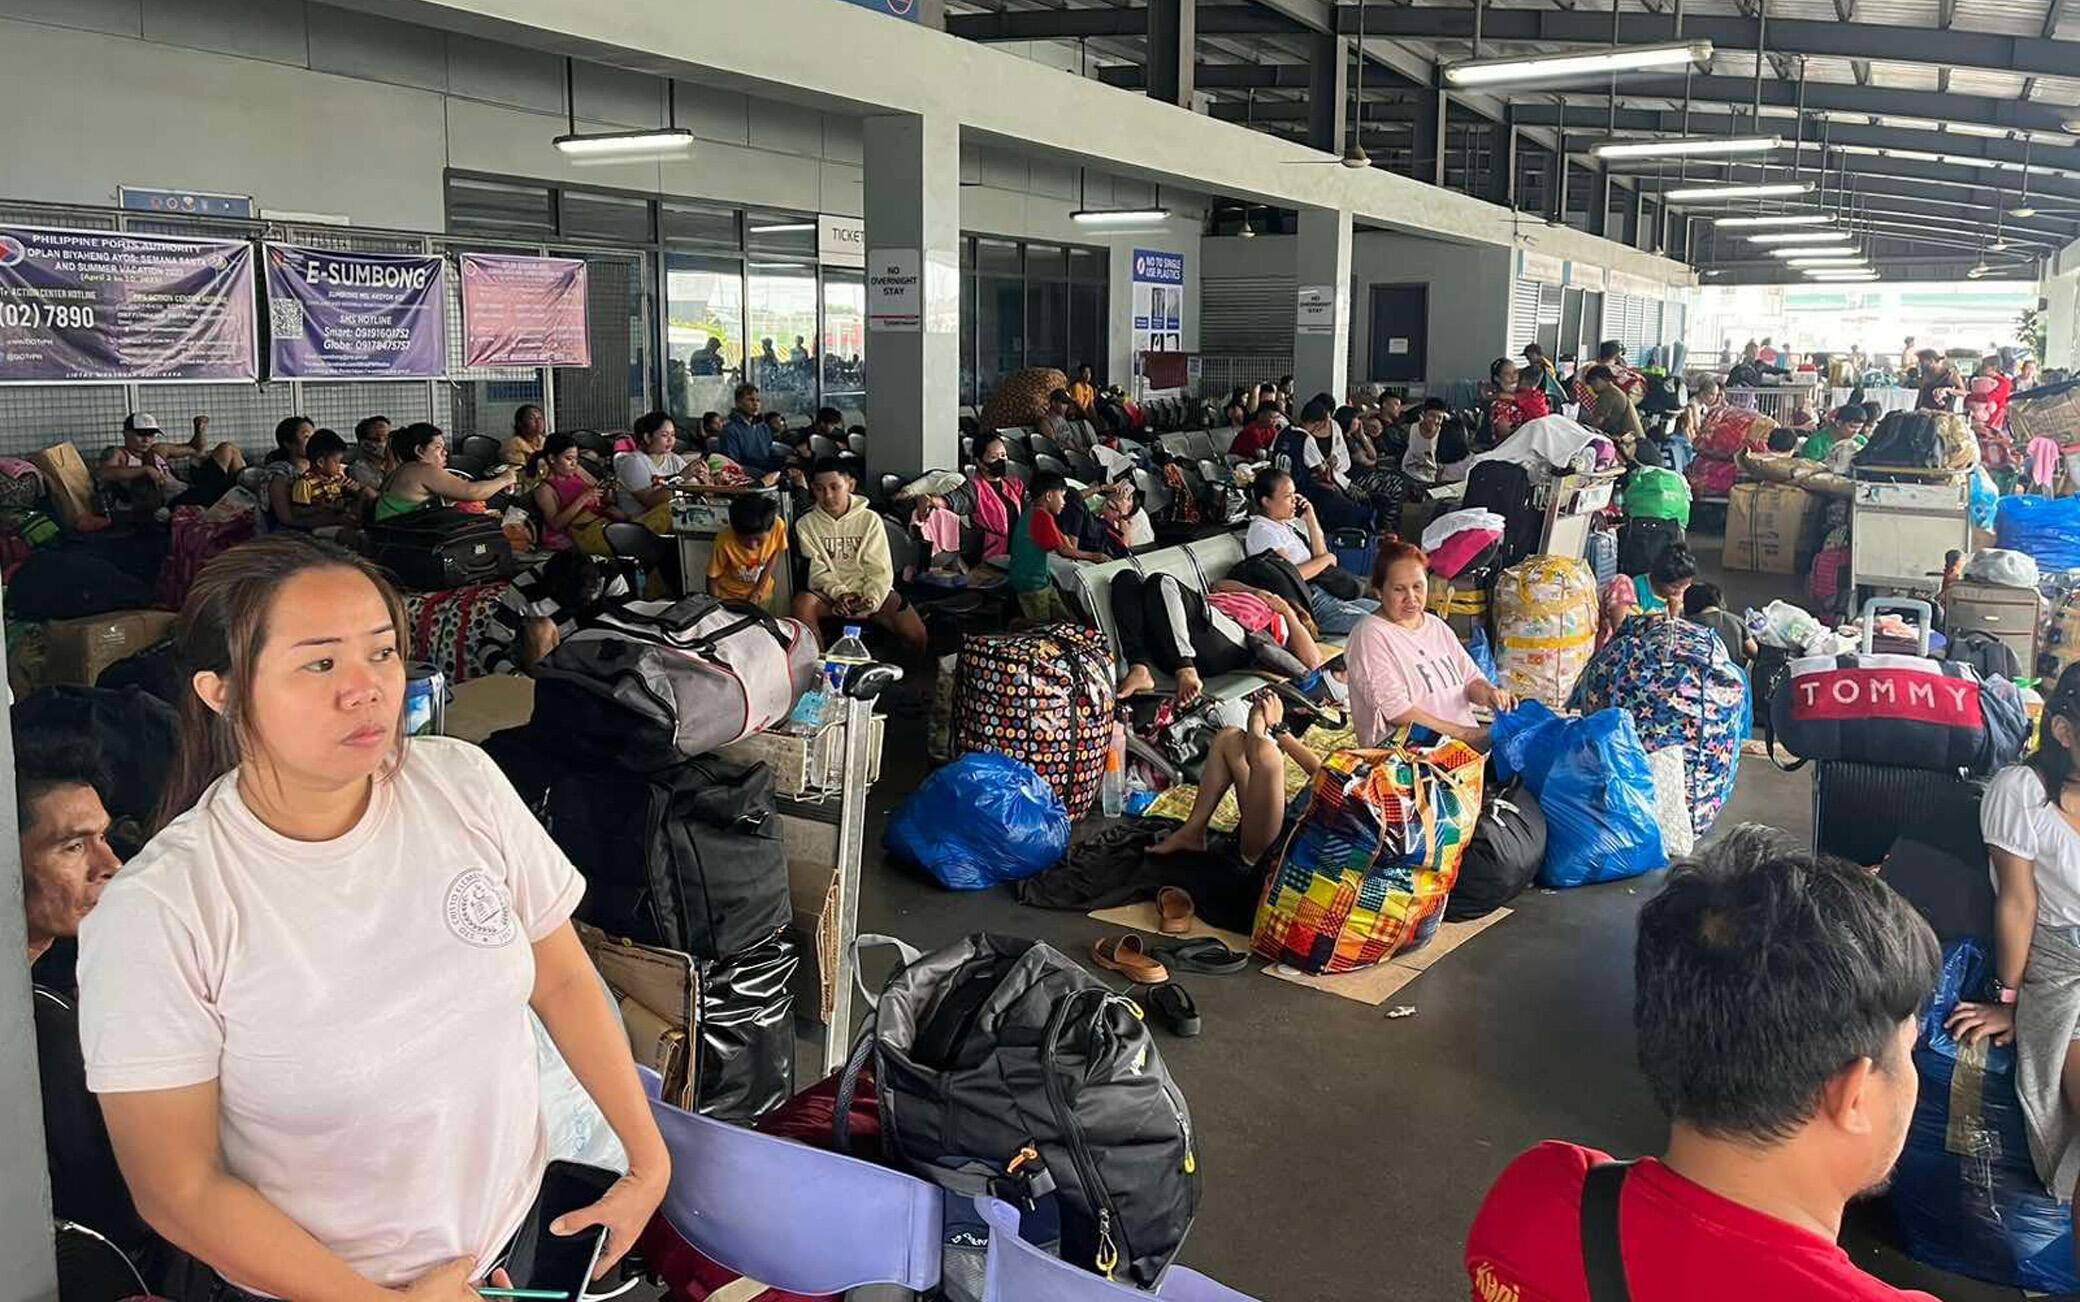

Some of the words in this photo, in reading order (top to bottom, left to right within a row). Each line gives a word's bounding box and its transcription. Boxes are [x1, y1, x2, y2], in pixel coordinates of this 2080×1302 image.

[33, 234, 99, 247] PHILIPPINE
[101, 238, 140, 250] PORTS
[142, 241, 201, 253] AUTHORITY
[27, 248, 60, 259] OPLAN
[140, 255, 178, 265] SEMANA
[55, 261, 76, 271] AND
[77, 262, 117, 273] SUMMER
[886, 266, 900, 275] NO
[306, 260, 426, 290] E-SUMBONG
[870, 276, 918, 286] OVERNIGHT
[883, 287, 905, 296] STAY
[0, 302, 40, 329] (02)
[43, 304, 95, 329] 7890
[357, 315, 392, 325] HOTLINE
[323, 326, 353, 338] Smart:
[323, 339, 353, 350] Globe:
[1800, 677, 1967, 712] TOMMY
